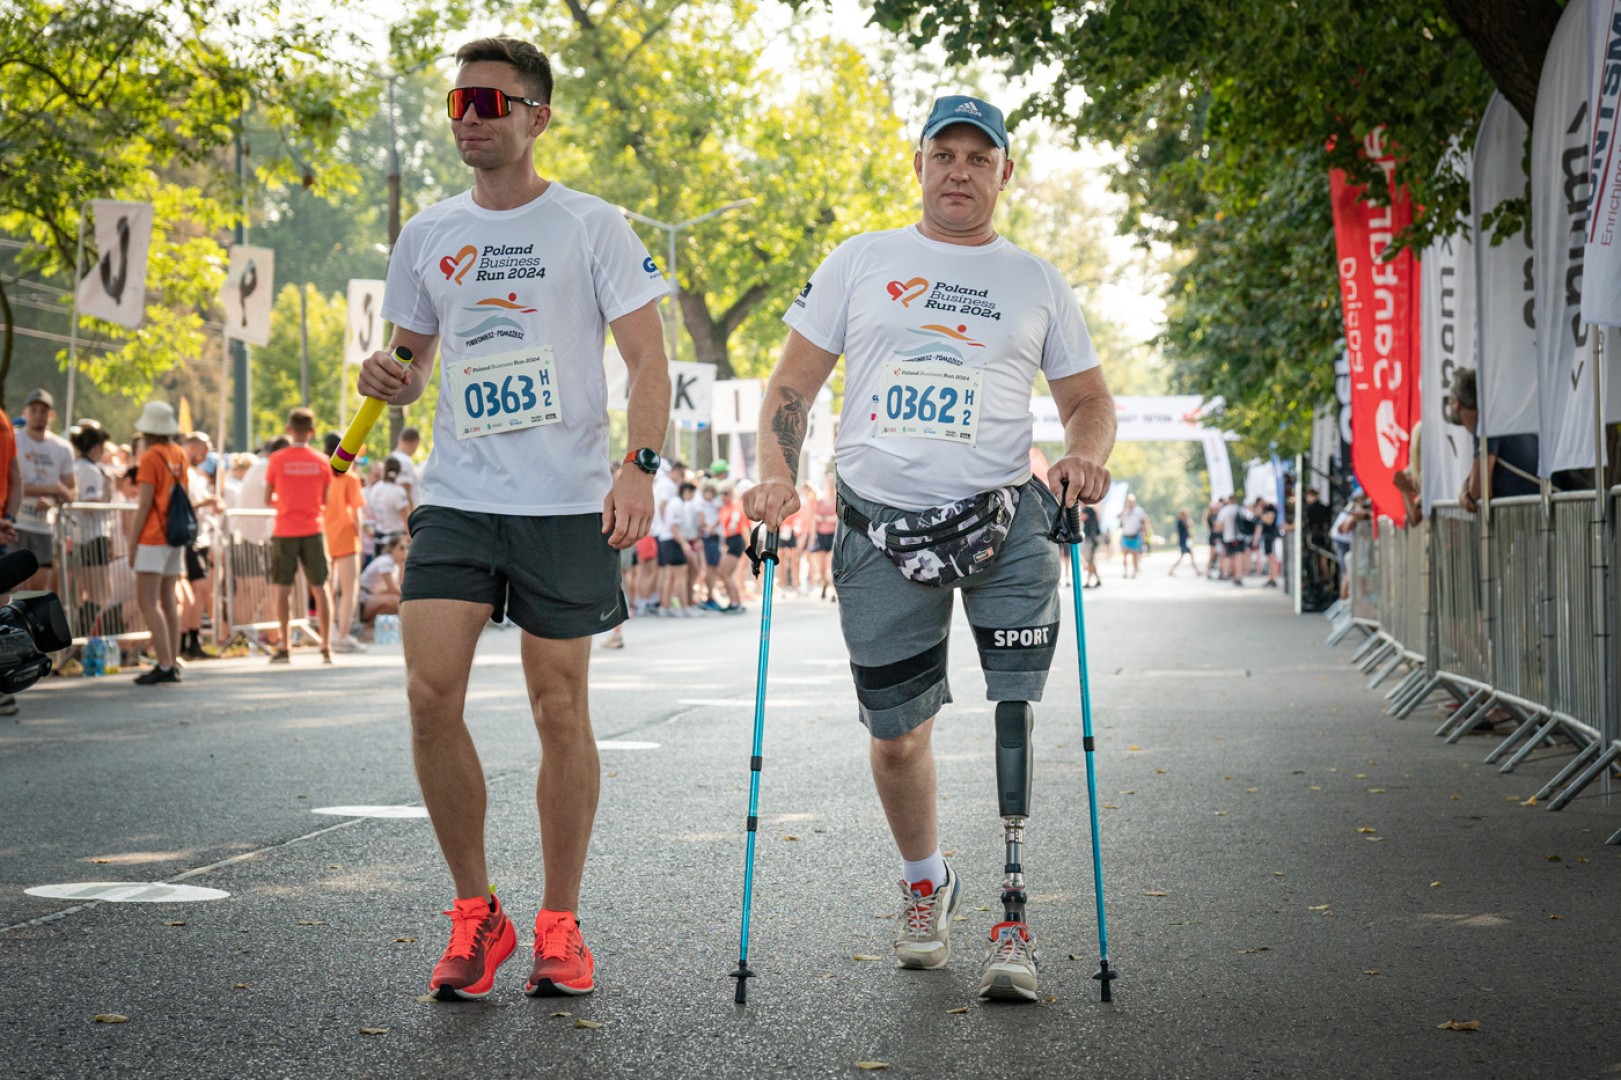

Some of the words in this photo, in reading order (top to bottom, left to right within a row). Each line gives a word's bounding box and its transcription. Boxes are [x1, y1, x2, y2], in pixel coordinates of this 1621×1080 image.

[482, 244, 534, 257] Poland
[479, 256, 541, 269] Business
[475, 270, 505, 281] Run
[508, 267, 546, 279] 2024
[933, 281, 988, 298] Poland
[930, 290, 996, 309] Business
[924, 299, 957, 312] Run
[959, 305, 1001, 321] 2024
[473, 365, 491, 373] Poland
[465, 375, 537, 419] 0363
[539, 369, 550, 385] H
[543, 390, 552, 407] 2
[674, 373, 697, 410] K
[887, 385, 958, 424] 0362
[964, 389, 975, 405] H
[962, 409, 972, 426] 2
[994, 627, 1050, 647] SPORT
